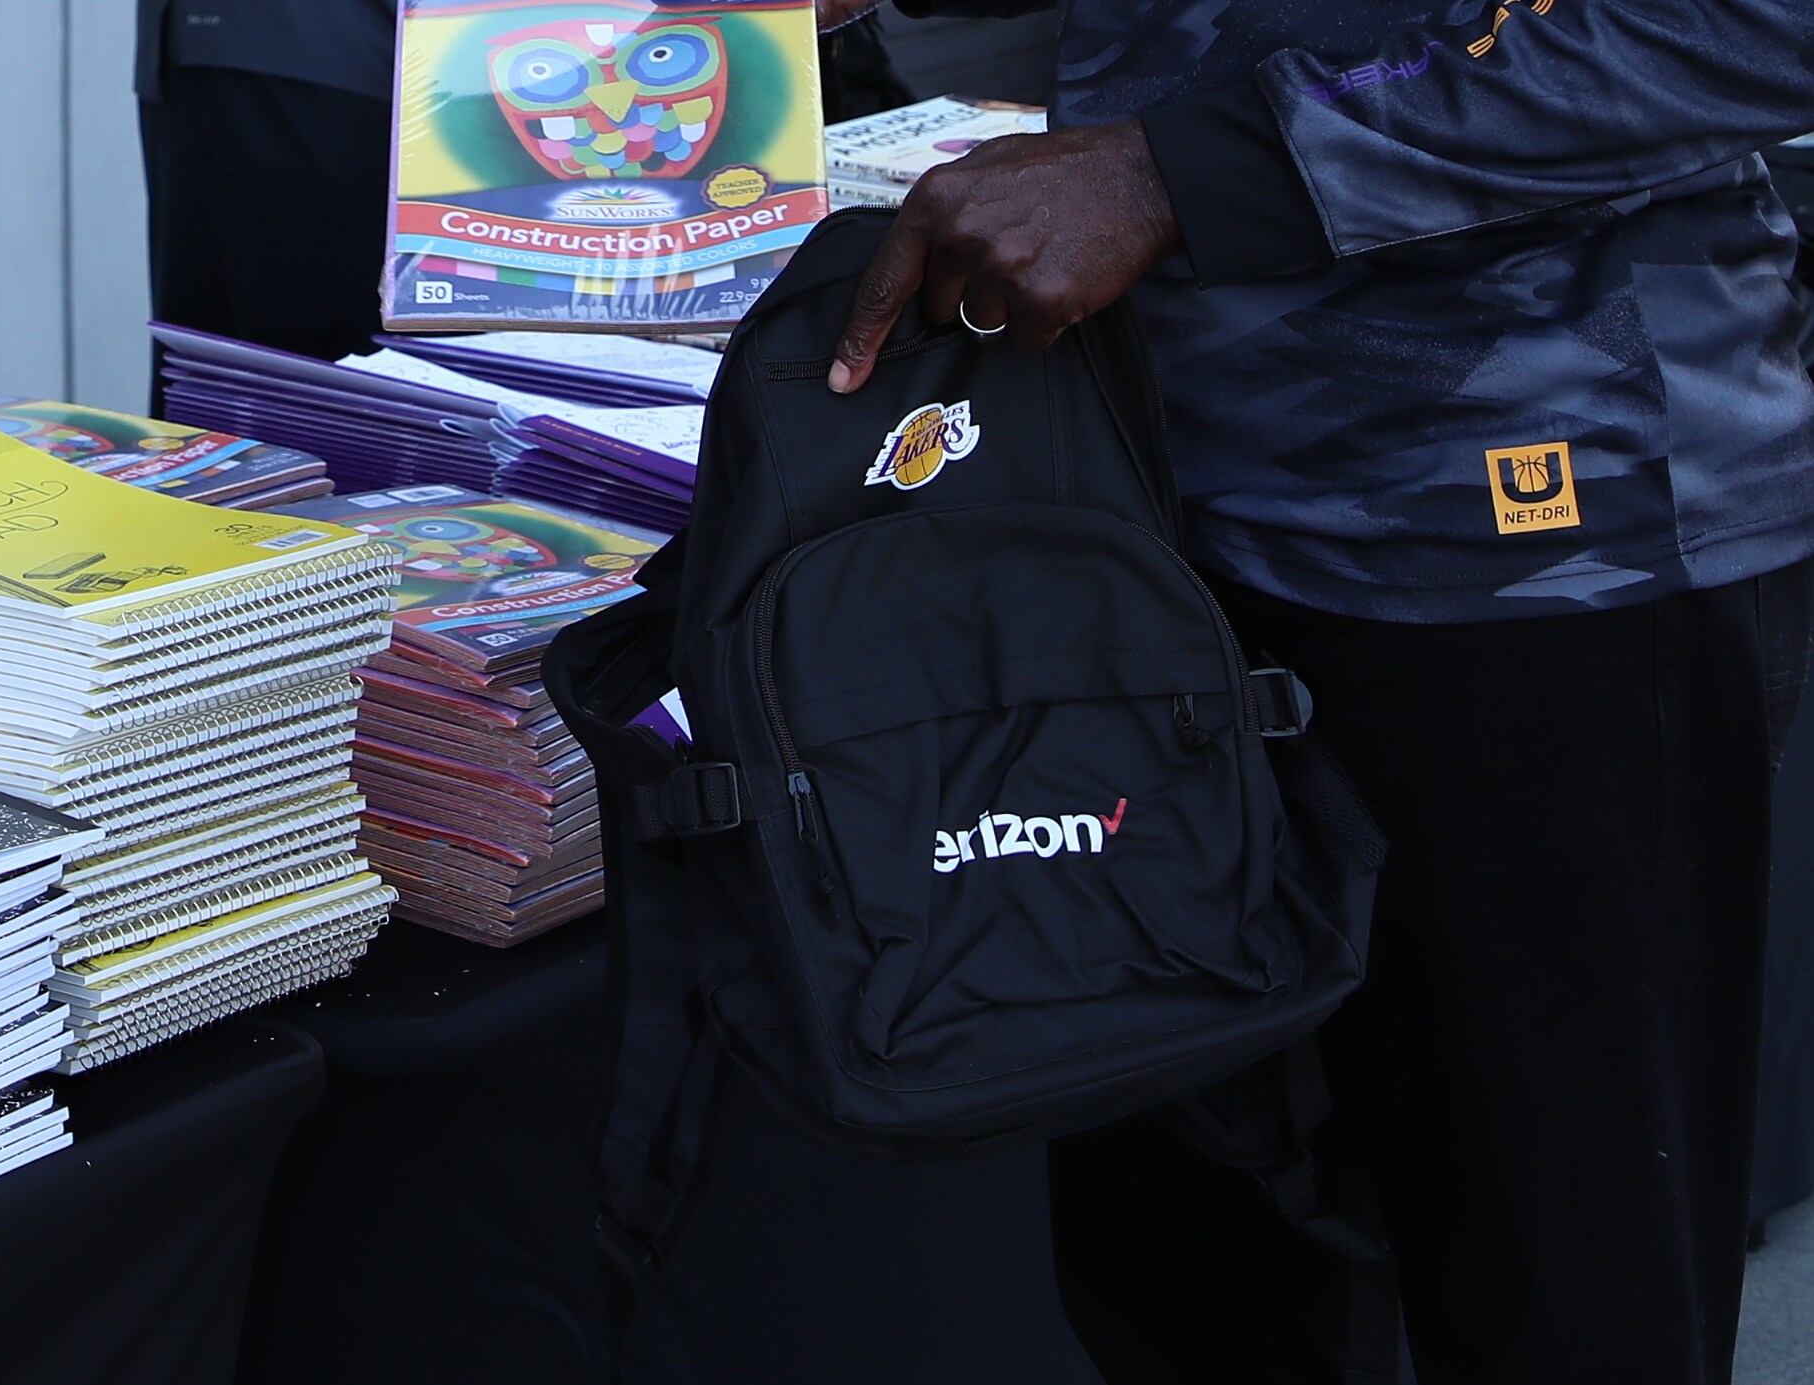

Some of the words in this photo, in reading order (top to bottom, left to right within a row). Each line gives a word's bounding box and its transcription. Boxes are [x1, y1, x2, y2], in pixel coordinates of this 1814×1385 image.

[440, 211, 675, 253] Construction
[684, 204, 789, 244] Paper
[473, 247, 582, 267] HEAVYWEIGHT
[614, 256, 693, 272] ASSORTED
[697, 240, 757, 262] COLORS
[422, 286, 447, 300] 50
[1504, 504, 1570, 524] NET-DRI
[431, 578, 613, 617] Construction
[933, 809, 1104, 873] erizon
